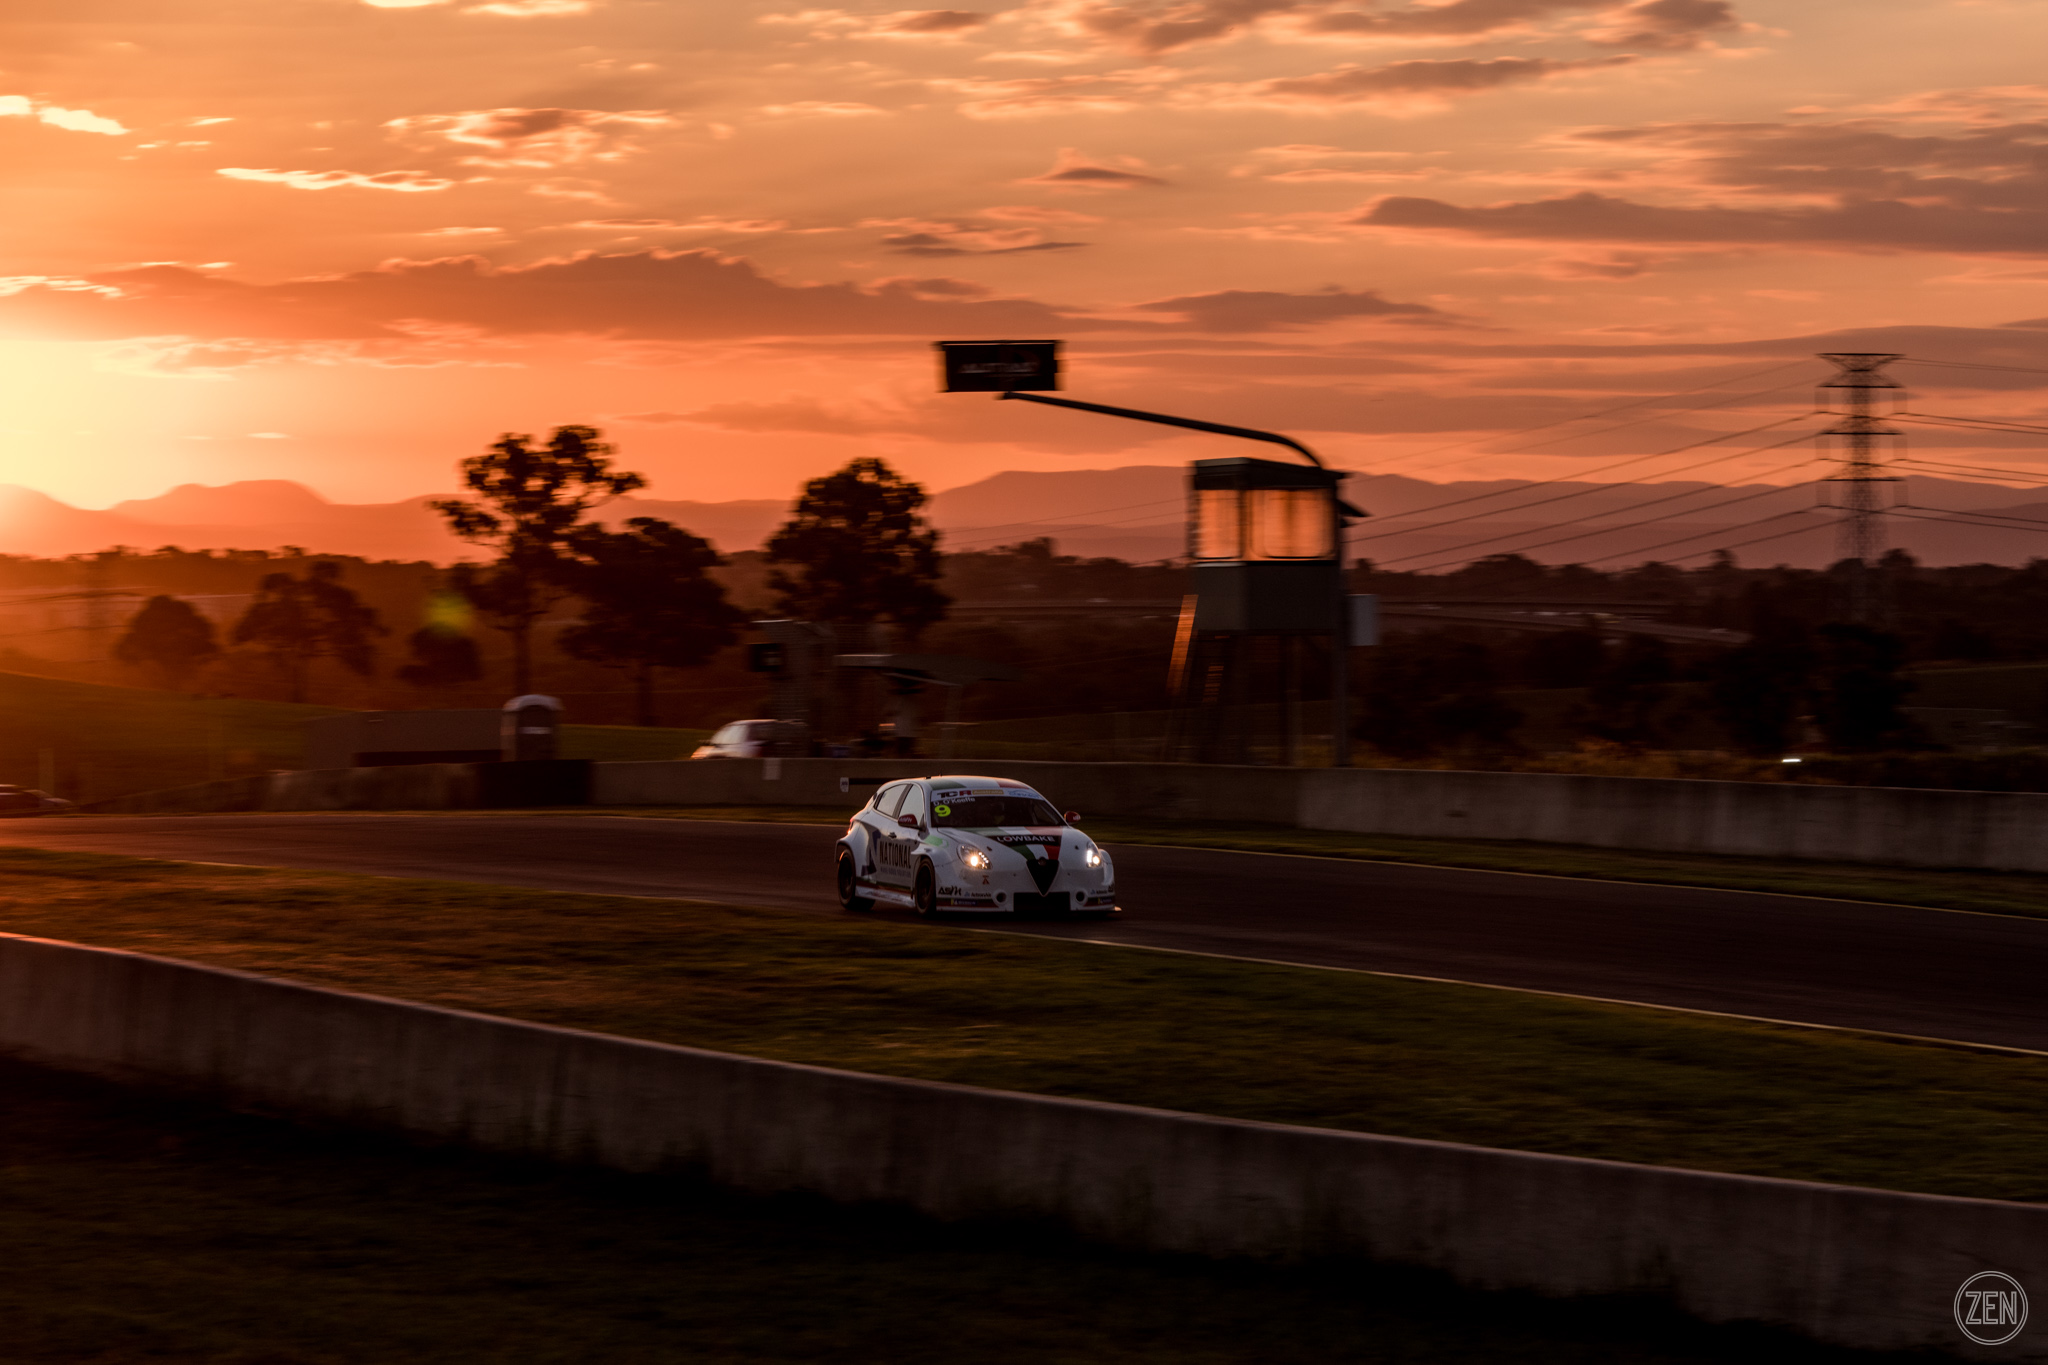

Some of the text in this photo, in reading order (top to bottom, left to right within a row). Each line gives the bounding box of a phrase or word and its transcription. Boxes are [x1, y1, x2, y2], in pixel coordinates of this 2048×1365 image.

[937, 790, 972, 798] TCR
[934, 804, 951, 817] 9
[996, 835, 1056, 843] LOWBAKE
[879, 841, 911, 869] NATIONAL
